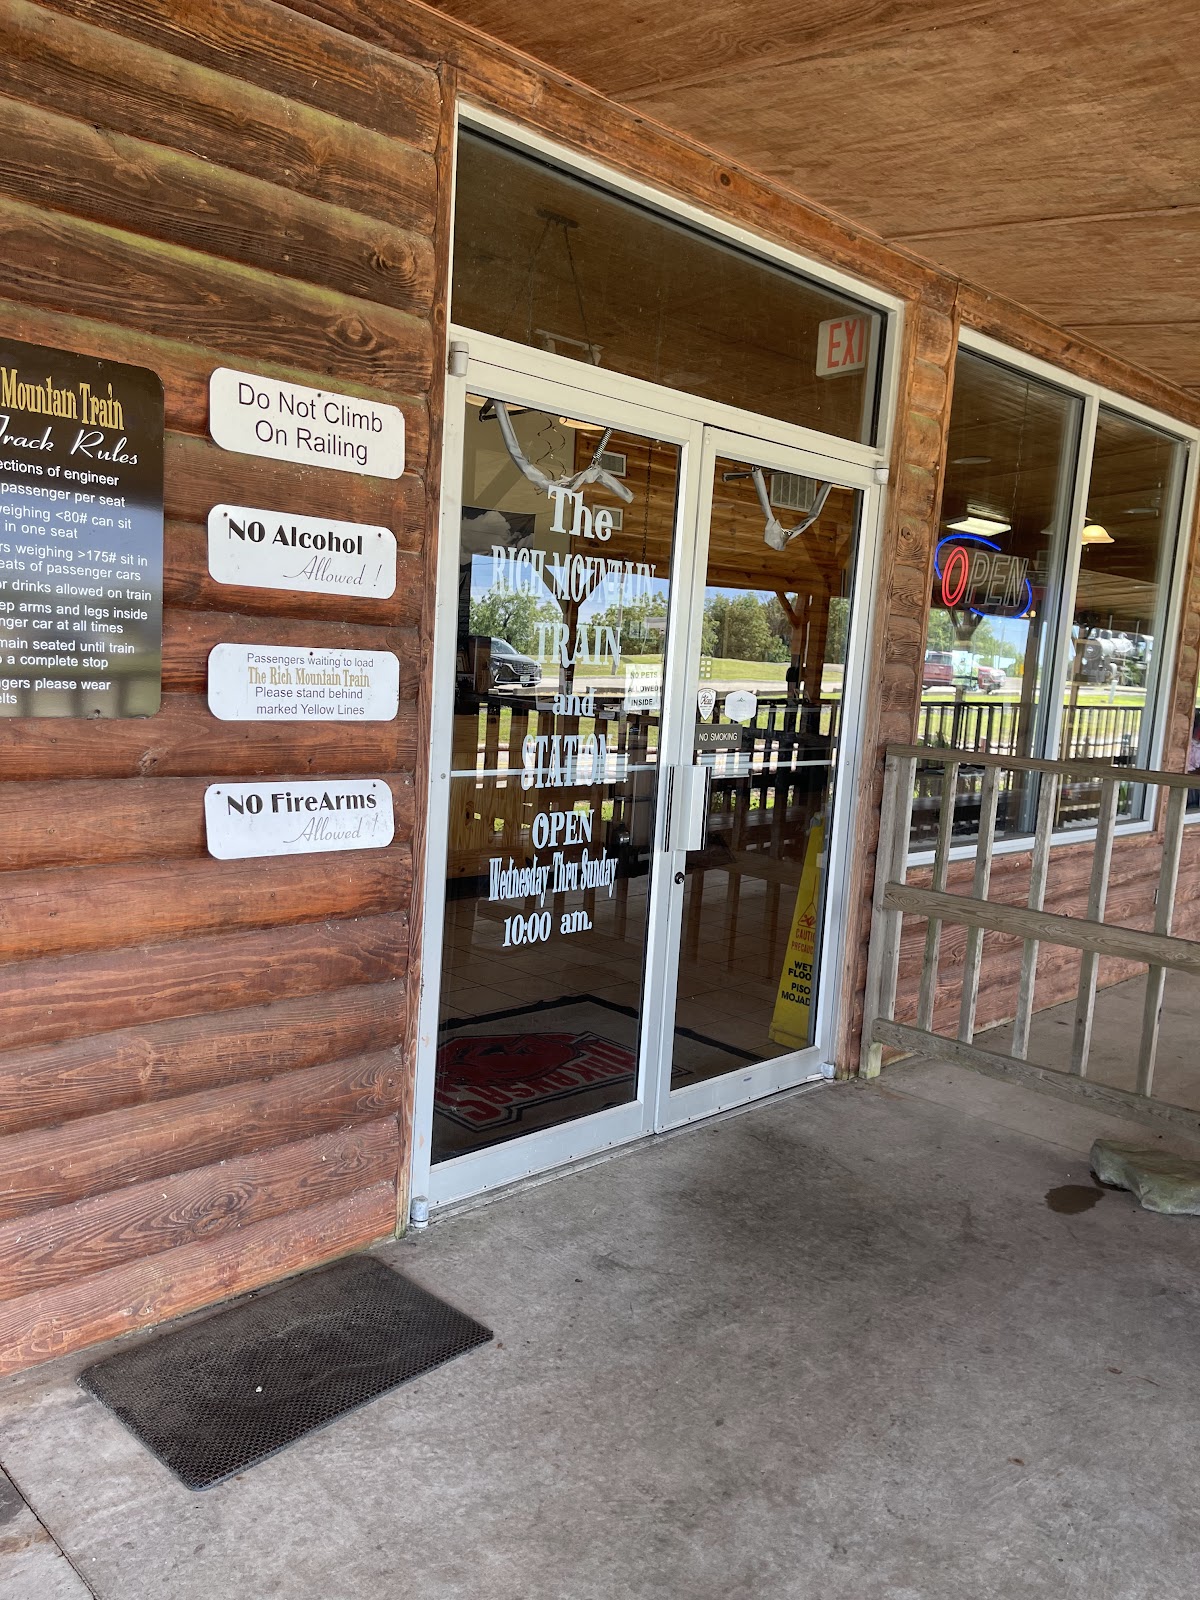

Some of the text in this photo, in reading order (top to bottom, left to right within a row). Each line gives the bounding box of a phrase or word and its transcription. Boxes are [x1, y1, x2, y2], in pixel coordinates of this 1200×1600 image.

[1, 366, 124, 430] Mountain Train
[238, 382, 383, 433] Do Not Climb
[70, 429, 138, 465] Rules
[255, 420, 368, 466] On Railing
[47, 466, 61, 478] of
[64, 469, 119, 486] engineer
[1, 482, 125, 508] passenger per seat
[56, 510, 87, 524] <80#
[91, 516, 114, 527] can
[118, 518, 132, 529] sit
[547, 485, 613, 541] The
[4, 520, 78, 539] in one seat
[228, 518, 363, 555] NO Alcohol
[15, 543, 73, 561] weighing
[77, 549, 117, 563] >175#
[120, 553, 134, 565] sit
[138, 555, 148, 566] in
[30, 561, 43, 572] of
[47, 564, 112, 580] passenger
[116, 571, 141, 581] cars
[283, 555, 365, 585] Allowed
[491, 545, 656, 607] RICH MOUNTAIN
[942, 546, 1029, 607] OPEN
[12, 579, 51, 593] drinks
[56, 584, 103, 597] allowed
[107, 589, 122, 599] on
[126, 588, 152, 601] train
[19, 602, 52, 614] arms
[56, 604, 80, 616] and
[84, 605, 109, 620] legs
[113, 607, 148, 620] inside
[32, 619, 53, 629] car
[57, 620, 69, 631] at
[73, 620, 87, 632] all
[91, 621, 124, 633] times
[33, 639, 76, 651] seated
[80, 641, 105, 653] until
[109, 642, 135, 654] train
[534, 621, 622, 669] TRAIN
[7, 655, 15, 664] a
[20, 655, 79, 668] complete
[83, 657, 108, 670] stop
[247, 652, 374, 668] Passengers waiting to load
[0, 678, 111, 691] gers please wear
[248, 665, 370, 688] The Rich Mountain Train
[641, 671, 658, 679] PETS
[255, 686, 363, 699] Please stand behind
[552, 687, 597, 717] and
[631, 698, 653, 706] INSIDE
[256, 703, 365, 715] marked Yellow Lines
[699, 732, 738, 742] NO SMOKING
[520, 733, 613, 790] STATION
[227, 792, 377, 815] NO FireArms
[283, 816, 362, 844] Allowed
[532, 809, 594, 850] OPEN
[488, 847, 618, 909] Wednesday Thru Sunday
[502, 909, 592, 947] 10:00 am.
[794, 960, 813, 973] WET
